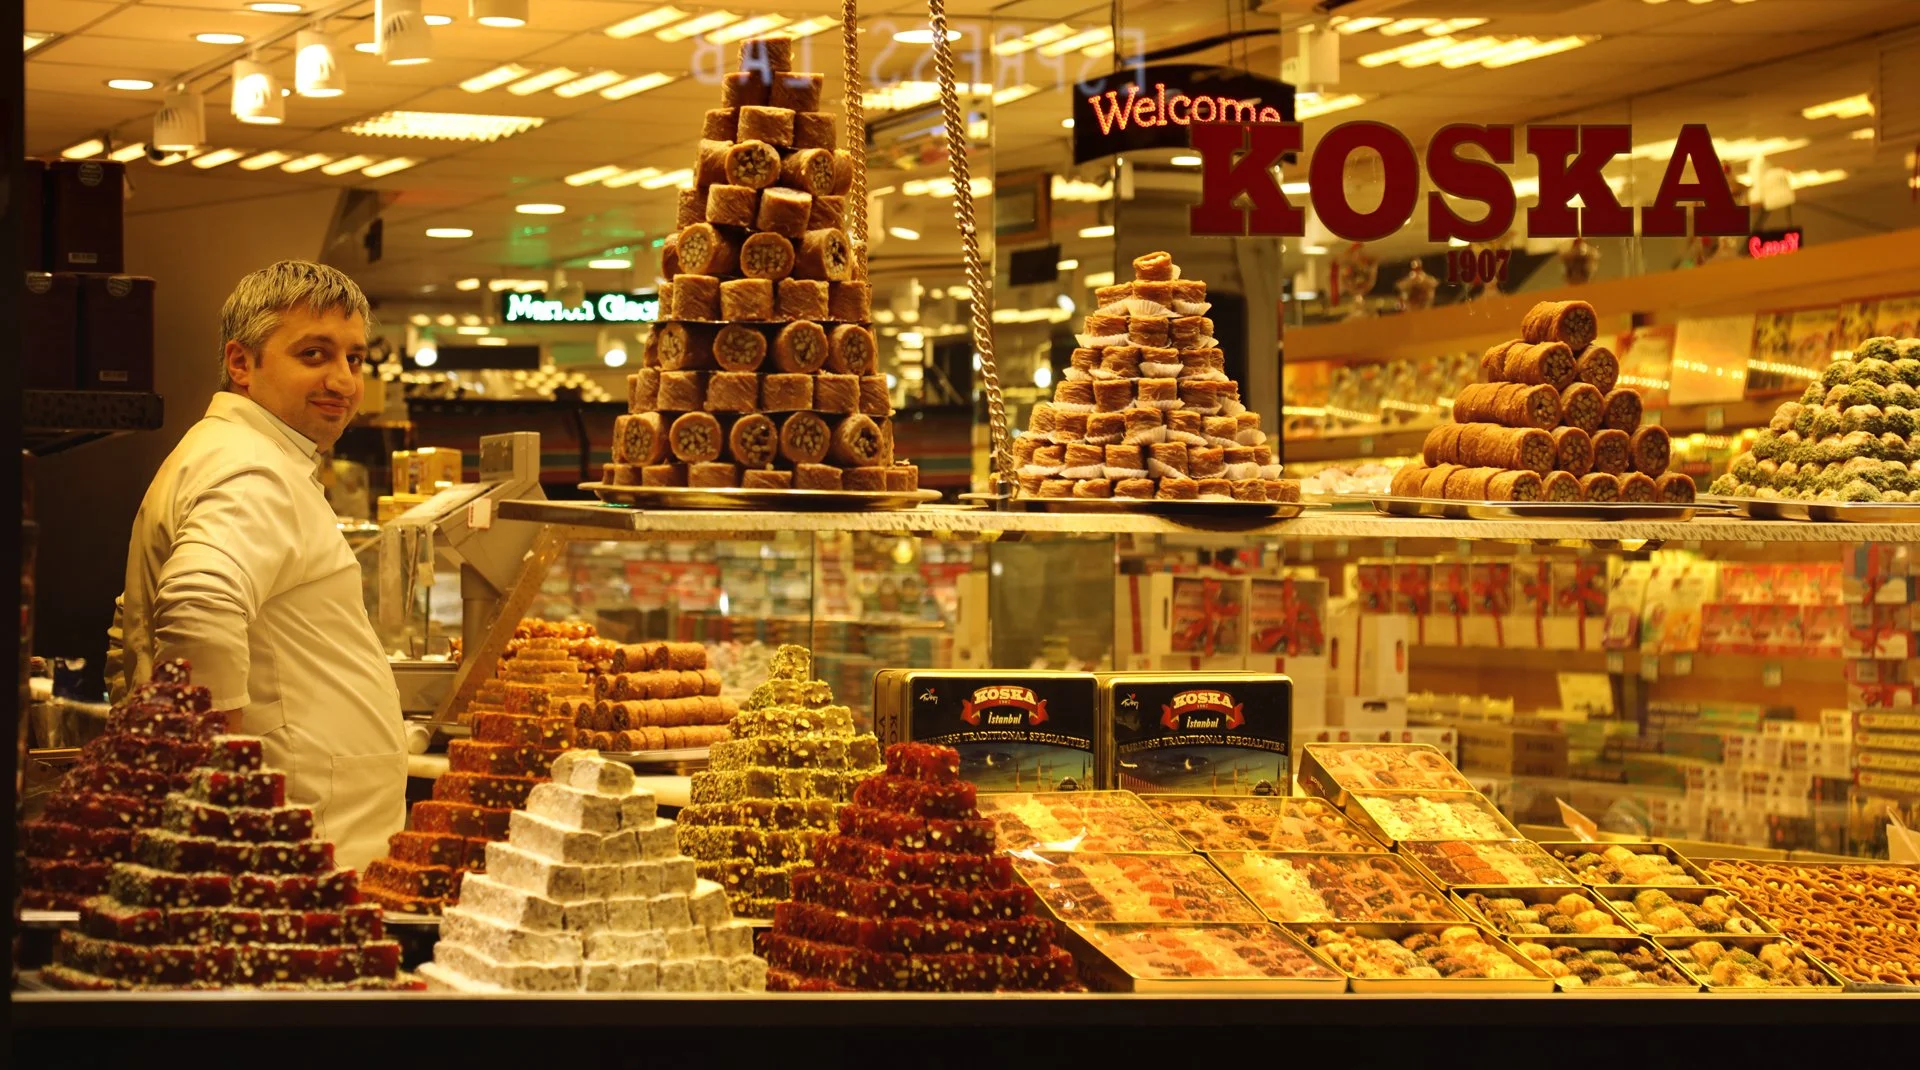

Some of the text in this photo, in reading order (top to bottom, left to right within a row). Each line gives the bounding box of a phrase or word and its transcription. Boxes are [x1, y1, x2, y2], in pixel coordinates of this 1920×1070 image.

[1088, 83, 1281, 136] Welcome
[1189, 120, 1751, 243] KOSKA
[1446, 248, 1512, 284] 1907
[973, 688, 1037, 705] KOSKA
[1173, 692, 1234, 710] KOSKA
[962, 730, 1028, 743] TRADITIONAL
[1029, 733, 1091, 750] SPECIALITIES
[1119, 733, 1285, 753] TURKISH TRADITIONAL SPECIALITIES
